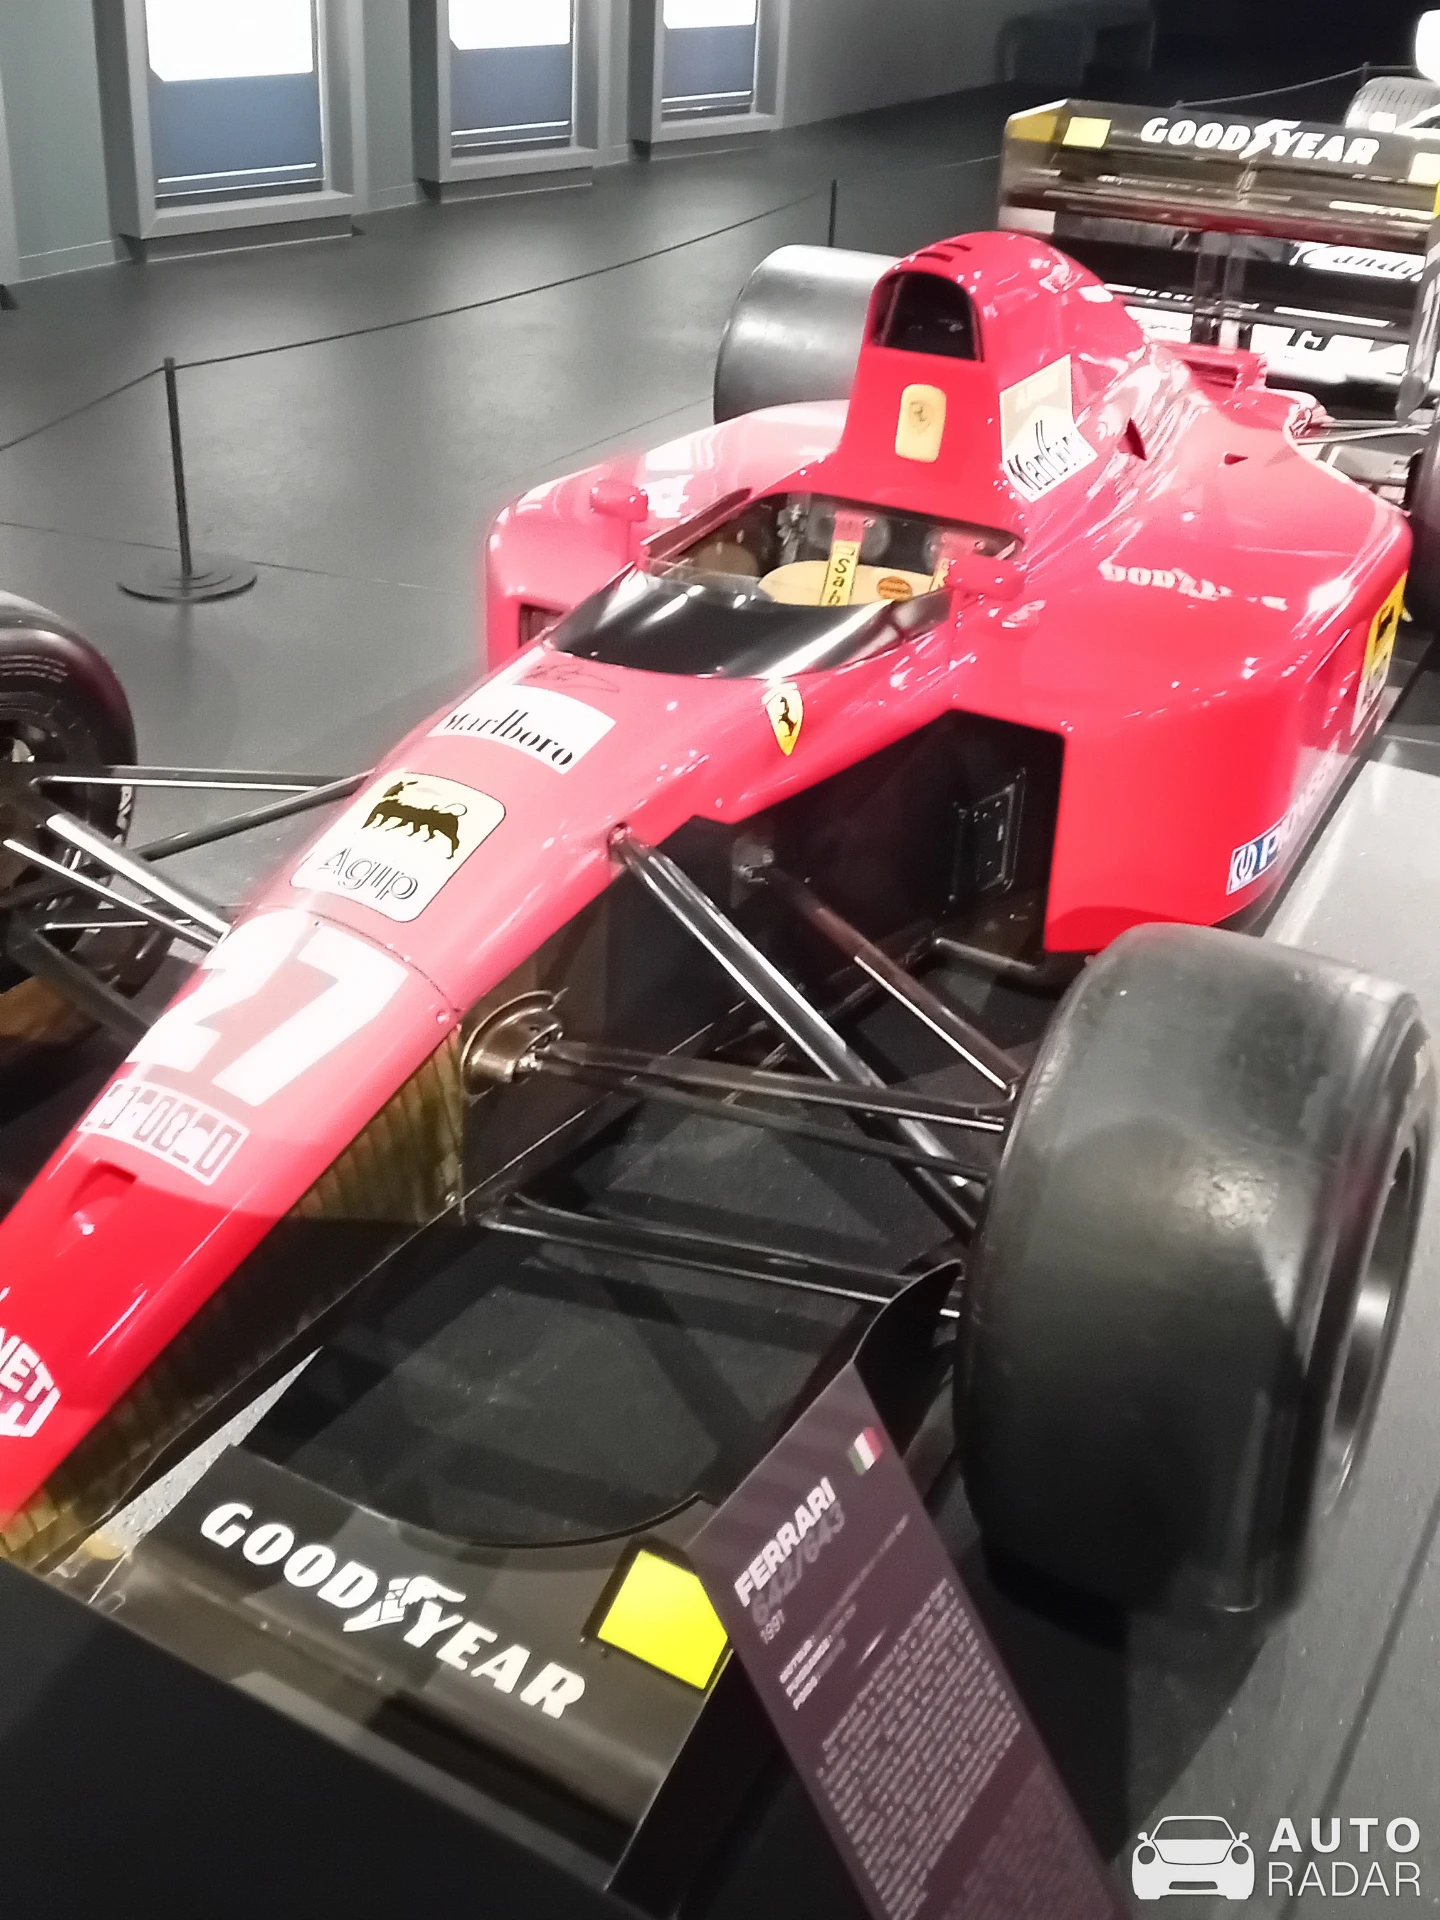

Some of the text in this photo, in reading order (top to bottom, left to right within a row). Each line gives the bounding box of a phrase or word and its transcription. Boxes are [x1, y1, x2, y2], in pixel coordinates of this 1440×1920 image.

[1140, 116, 1380, 166] GOODYEAR
[444, 709, 573, 766] Marlboro
[317, 847, 419, 900] Agip
[126, 907, 409, 1106] 27
[734, 1476, 837, 1607] FERRARI
[200, 1502, 586, 1720] GOODYEAR
[759, 1608, 786, 1645] 1991
